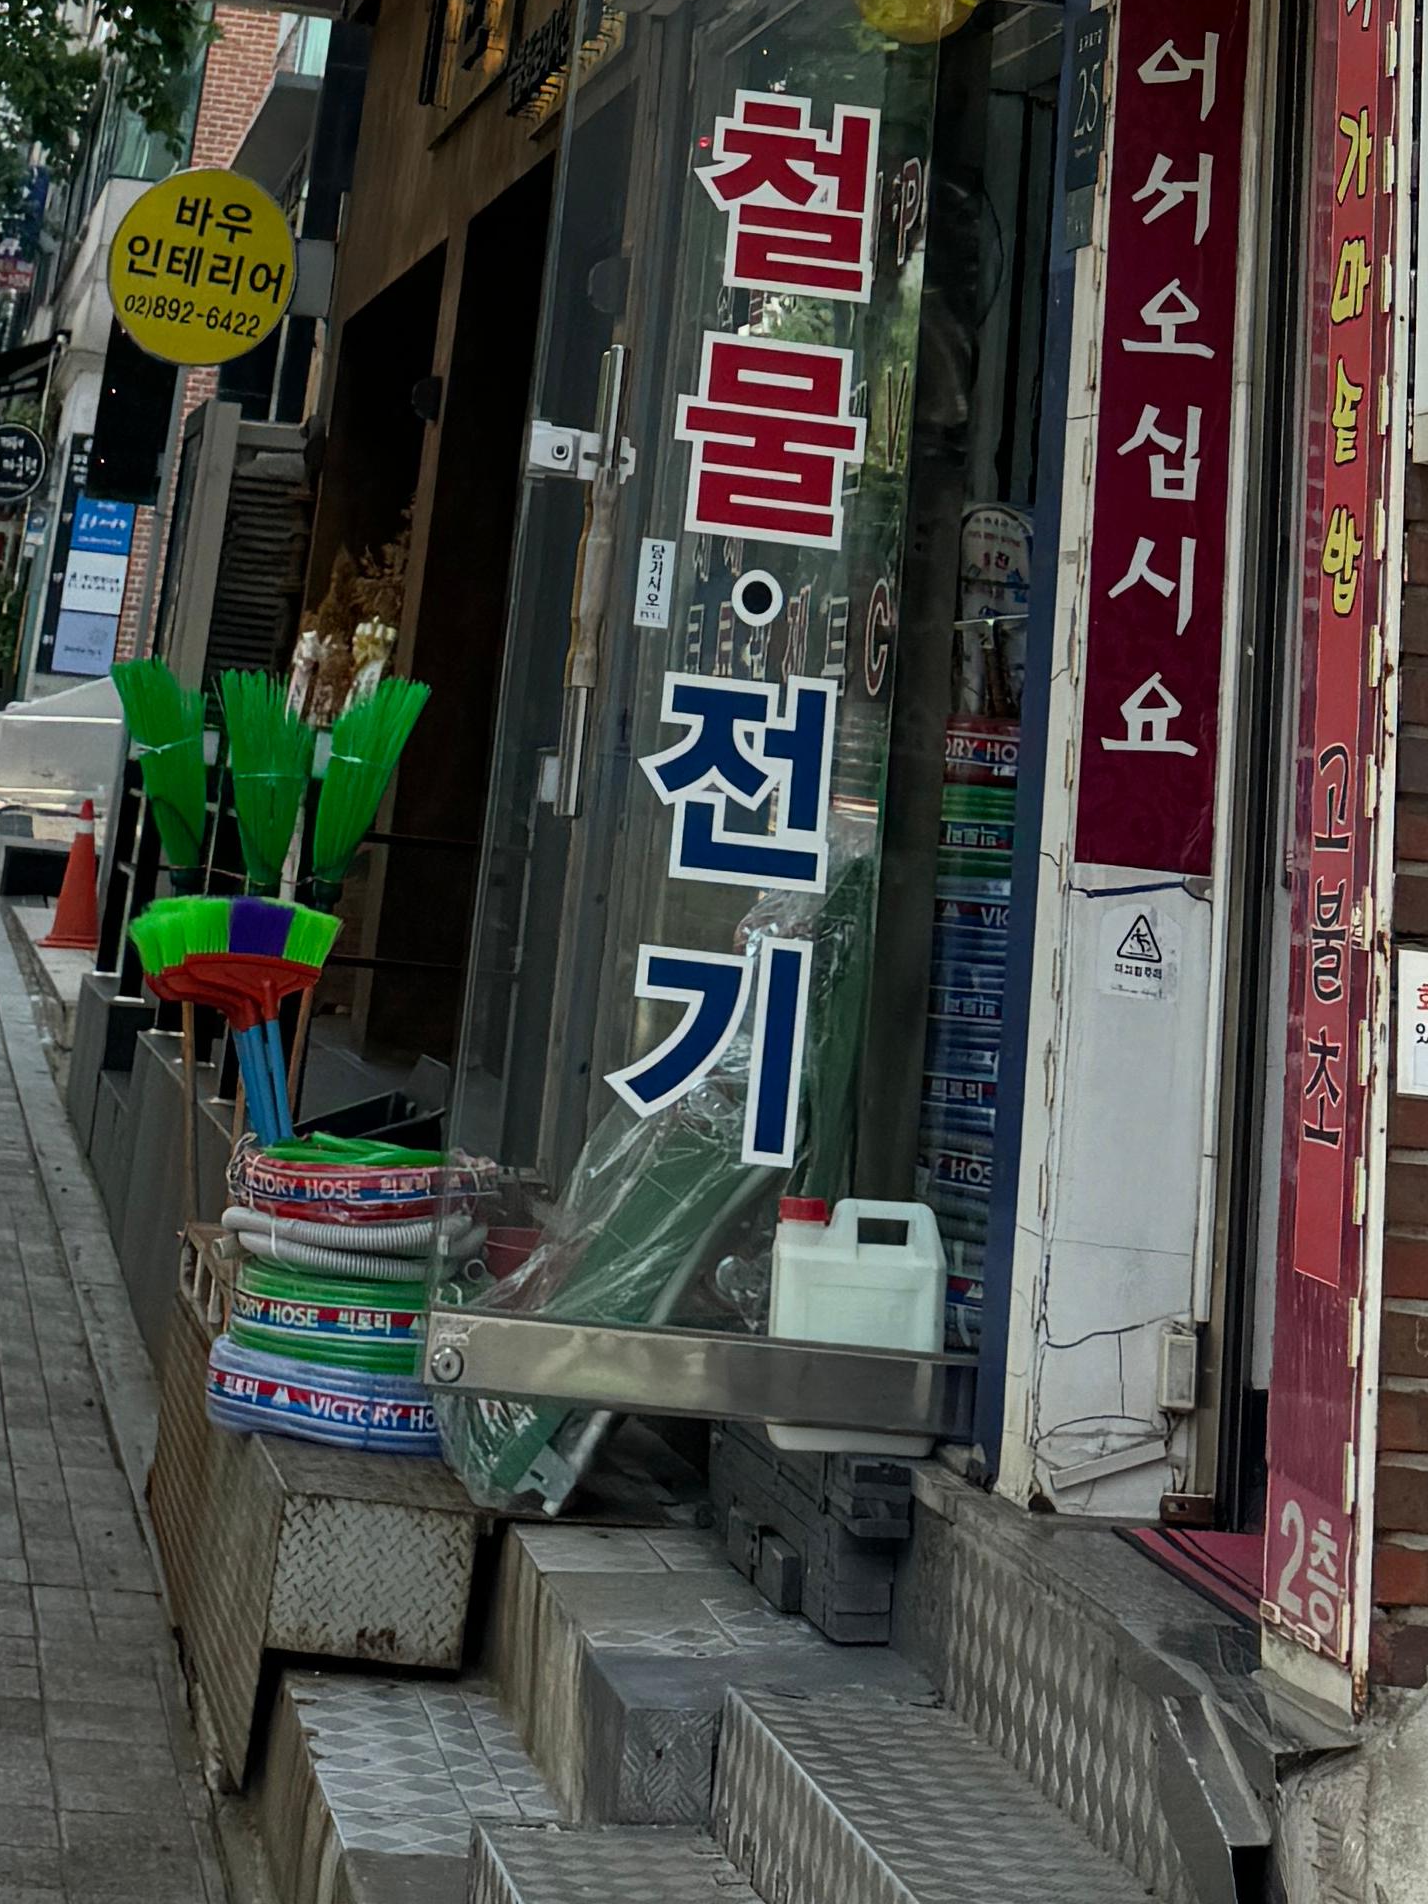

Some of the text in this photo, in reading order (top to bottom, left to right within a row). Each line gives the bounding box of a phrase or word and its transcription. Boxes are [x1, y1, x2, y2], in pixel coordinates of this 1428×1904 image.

[1073, 61, 1100, 138] 25
[175, 195, 254, 244] 바우
[127, 234, 286, 304] 인테리어
[124, 294, 262, 339] 02)892-6422
[1101, 31, 1220, 758] 어서오십시요
[1303, 743, 1352, 1149] 고불초
[305, 1179, 362, 1200] HOSE
[269, 1305, 319, 1328] HOSE
[1277, 1500, 1340, 1634] 2층
